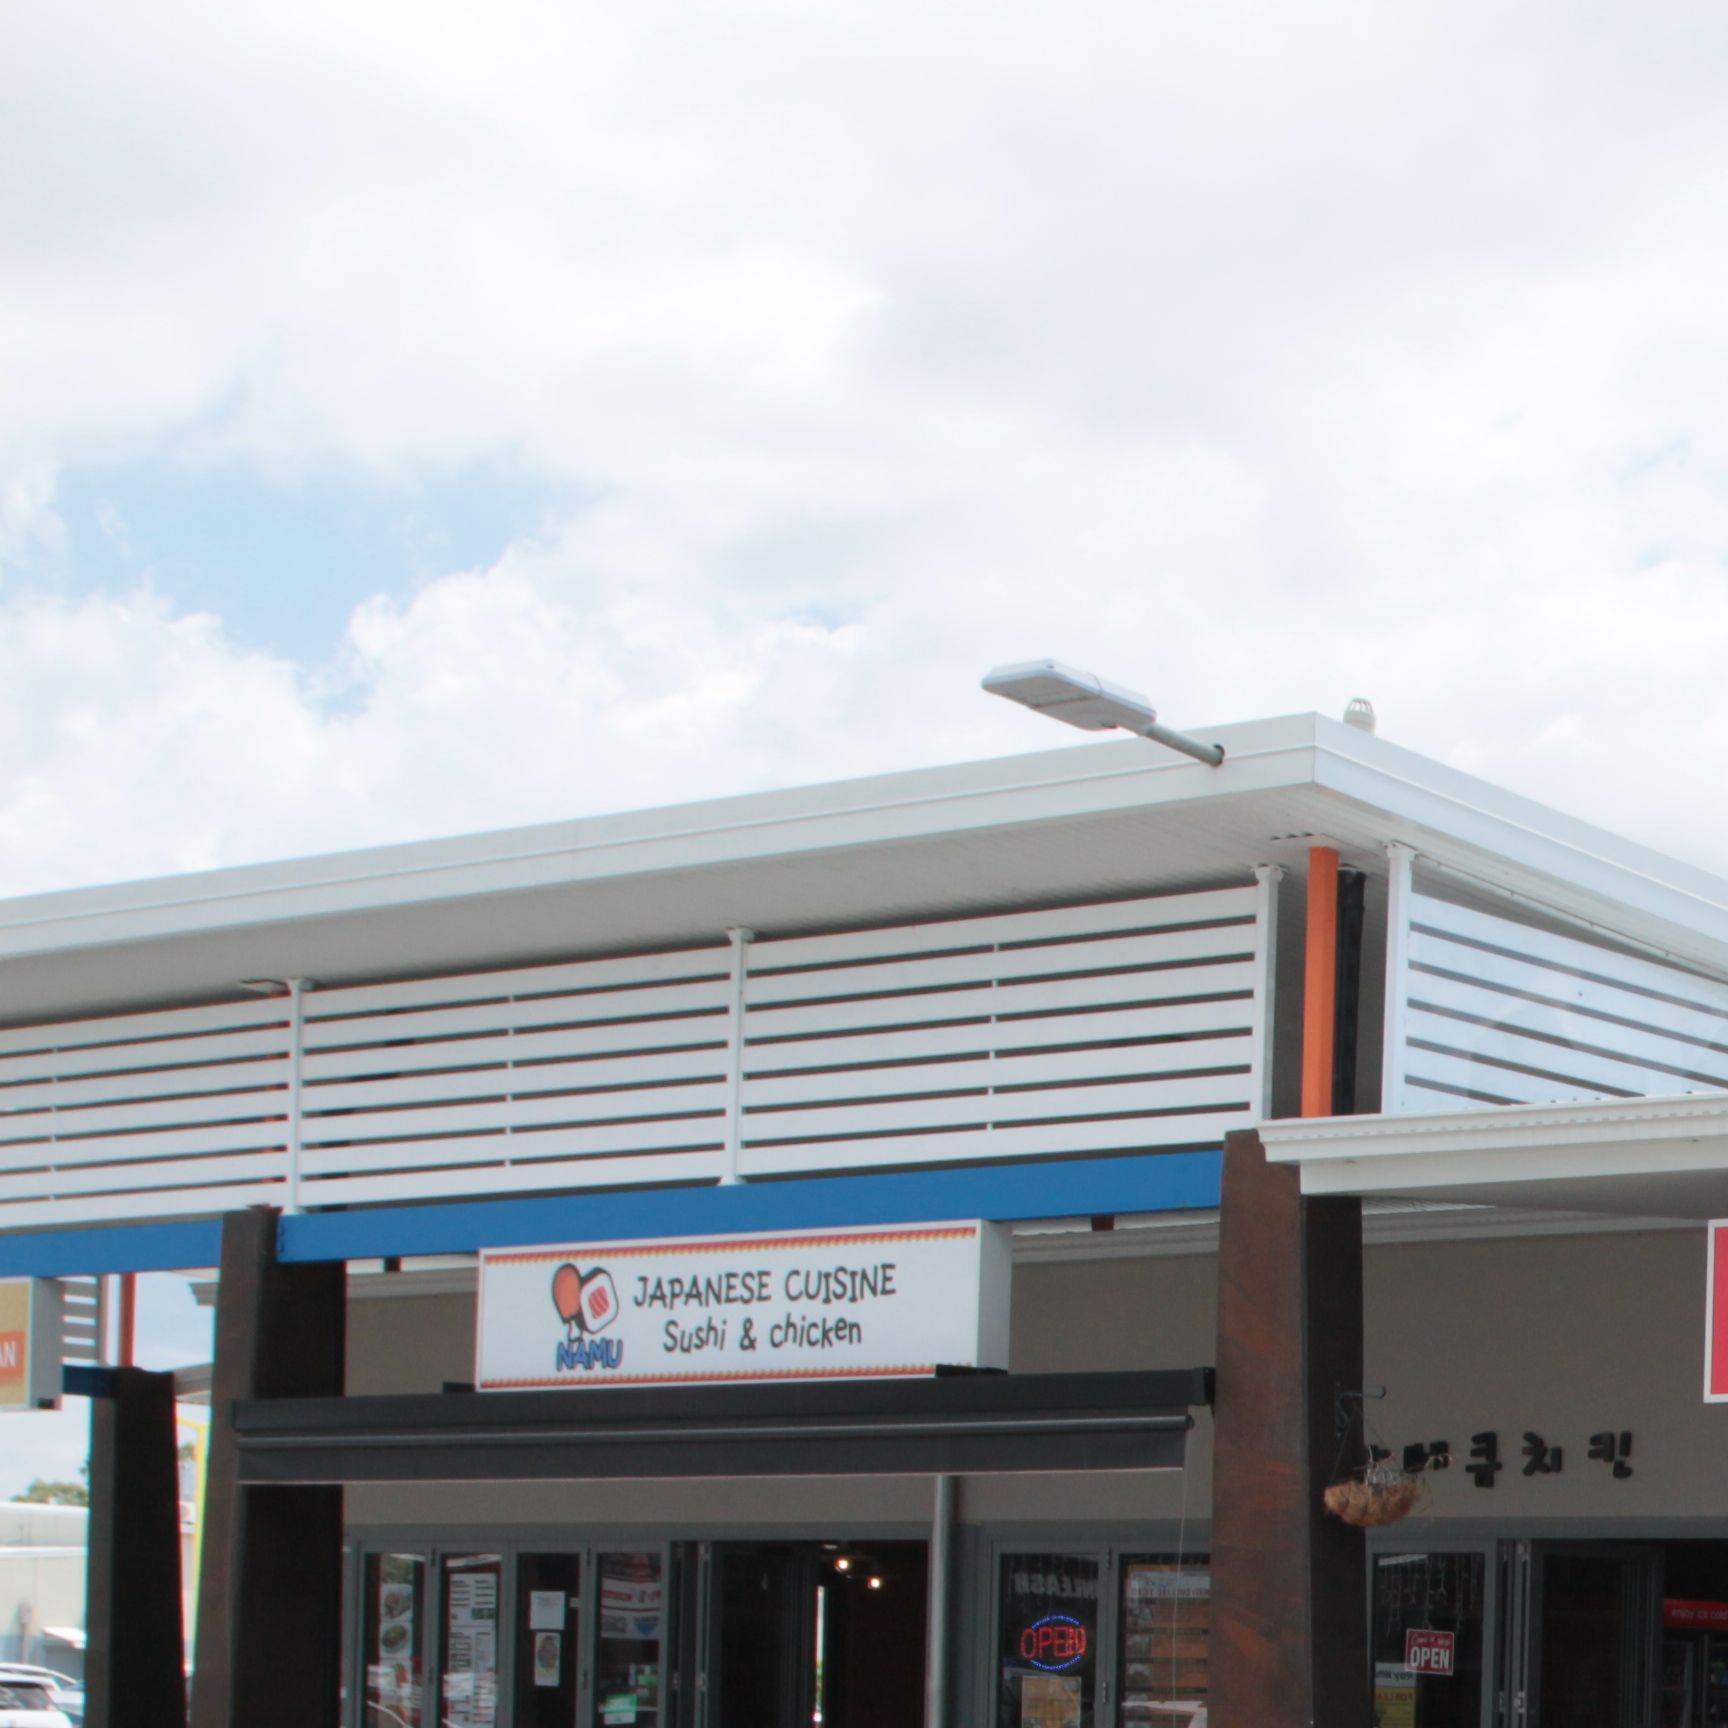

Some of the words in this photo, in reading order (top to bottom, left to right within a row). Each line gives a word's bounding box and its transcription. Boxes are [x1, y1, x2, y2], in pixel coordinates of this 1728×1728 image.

[634, 1272, 772, 1309] JAPANESE
[785, 1264, 897, 1303] CUISINE
[662, 1318, 727, 1353] Sushi
[739, 1317, 757, 1351] &
[770, 1313, 862, 1348] chicken
[556, 1338, 623, 1371] NAMU
[1020, 1625, 1087, 1659] OPEN
[1410, 1646, 1450, 1669] OPEN
